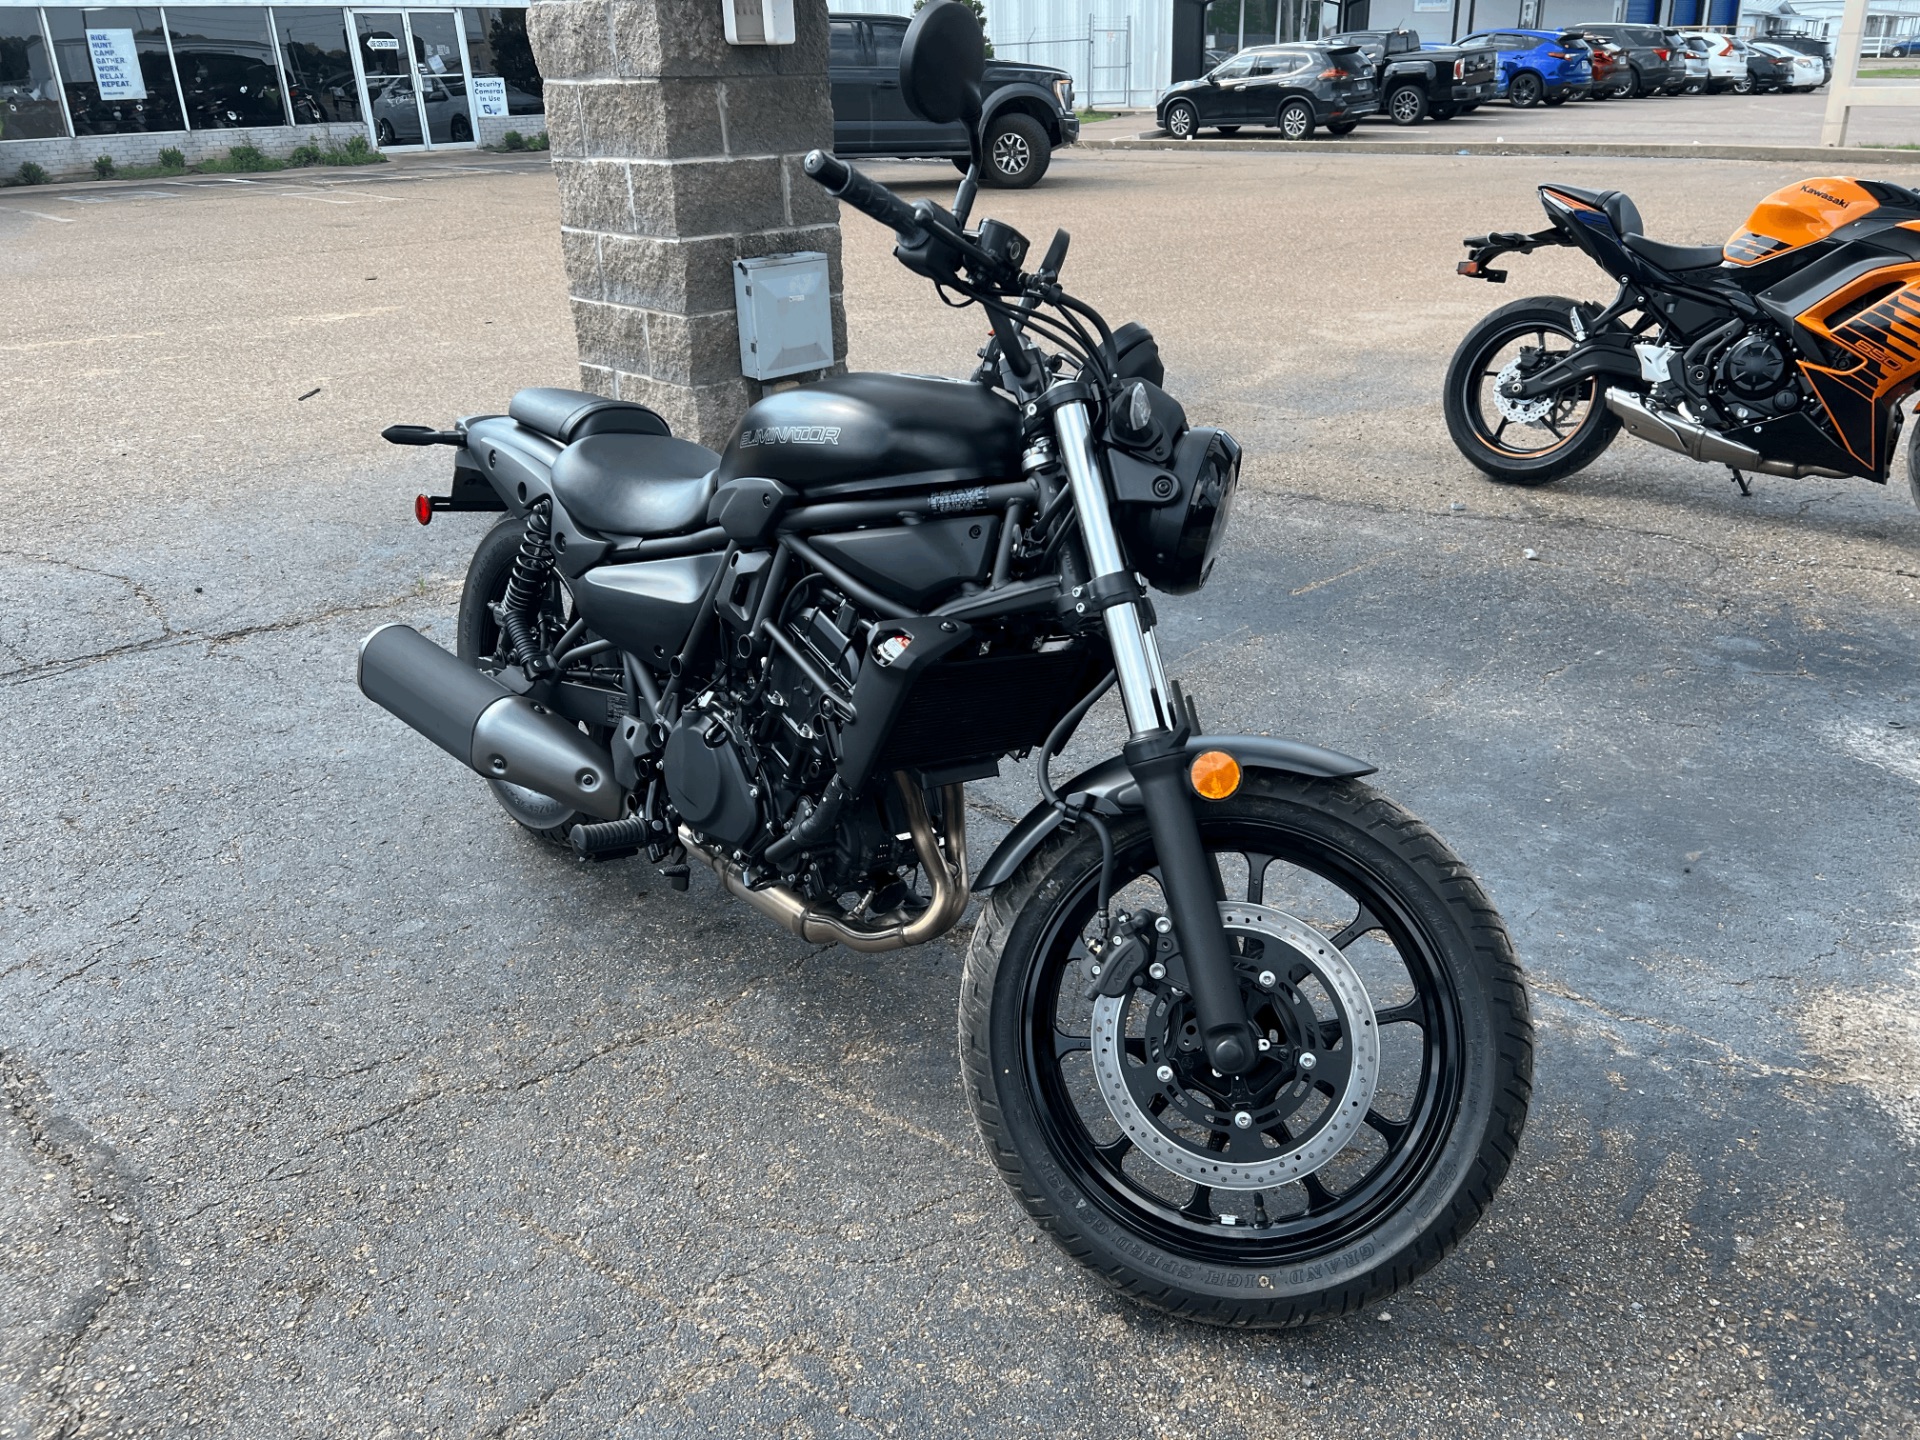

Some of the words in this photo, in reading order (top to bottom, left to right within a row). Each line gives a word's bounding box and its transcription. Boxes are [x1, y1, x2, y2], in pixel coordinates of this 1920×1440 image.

[475, 80, 502, 88] Security
[1800, 184, 1850, 209] Kawasaki
[1854, 340, 1902, 371] 650
[740, 426, 842, 449] ELIMINATOR
[1114, 1234, 1195, 1280] SPEED
[1288, 1241, 1375, 1285] GRAND
[1205, 1270, 1276, 1289] HIGH
